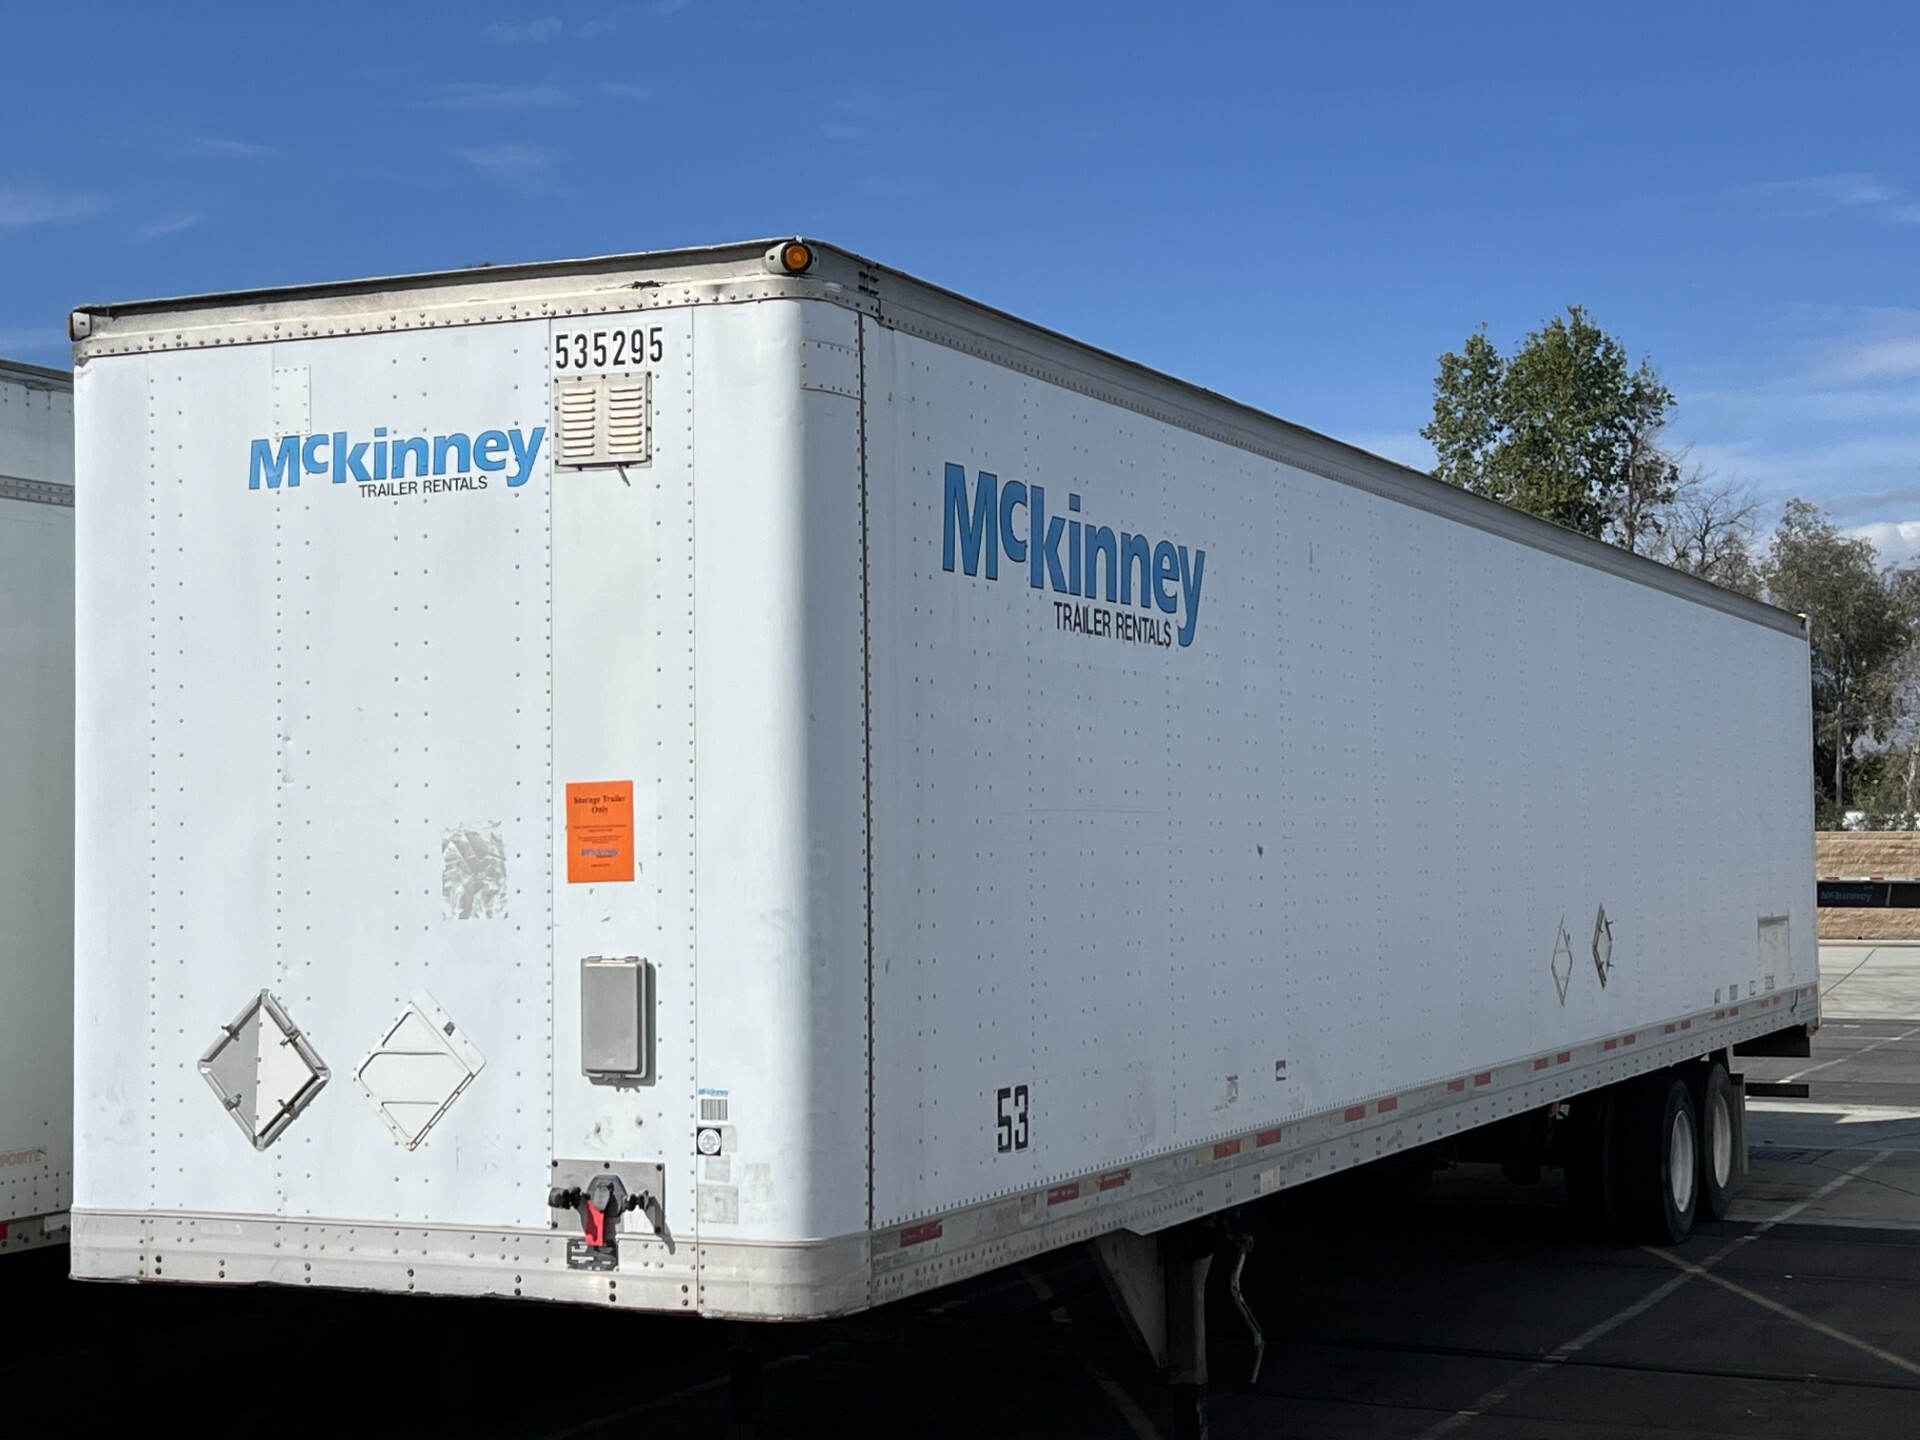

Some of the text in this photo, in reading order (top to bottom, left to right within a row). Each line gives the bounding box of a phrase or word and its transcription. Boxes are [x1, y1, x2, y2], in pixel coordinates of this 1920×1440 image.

[555, 327, 663, 369] 535295
[359, 475, 488, 498] TRAILER RENTALS
[1053, 601, 1172, 647] TRAILER RENTALS
[573, 794, 626, 805] Storage Trailer
[591, 805, 608, 815] Only
[997, 1084, 1029, 1153] 53
